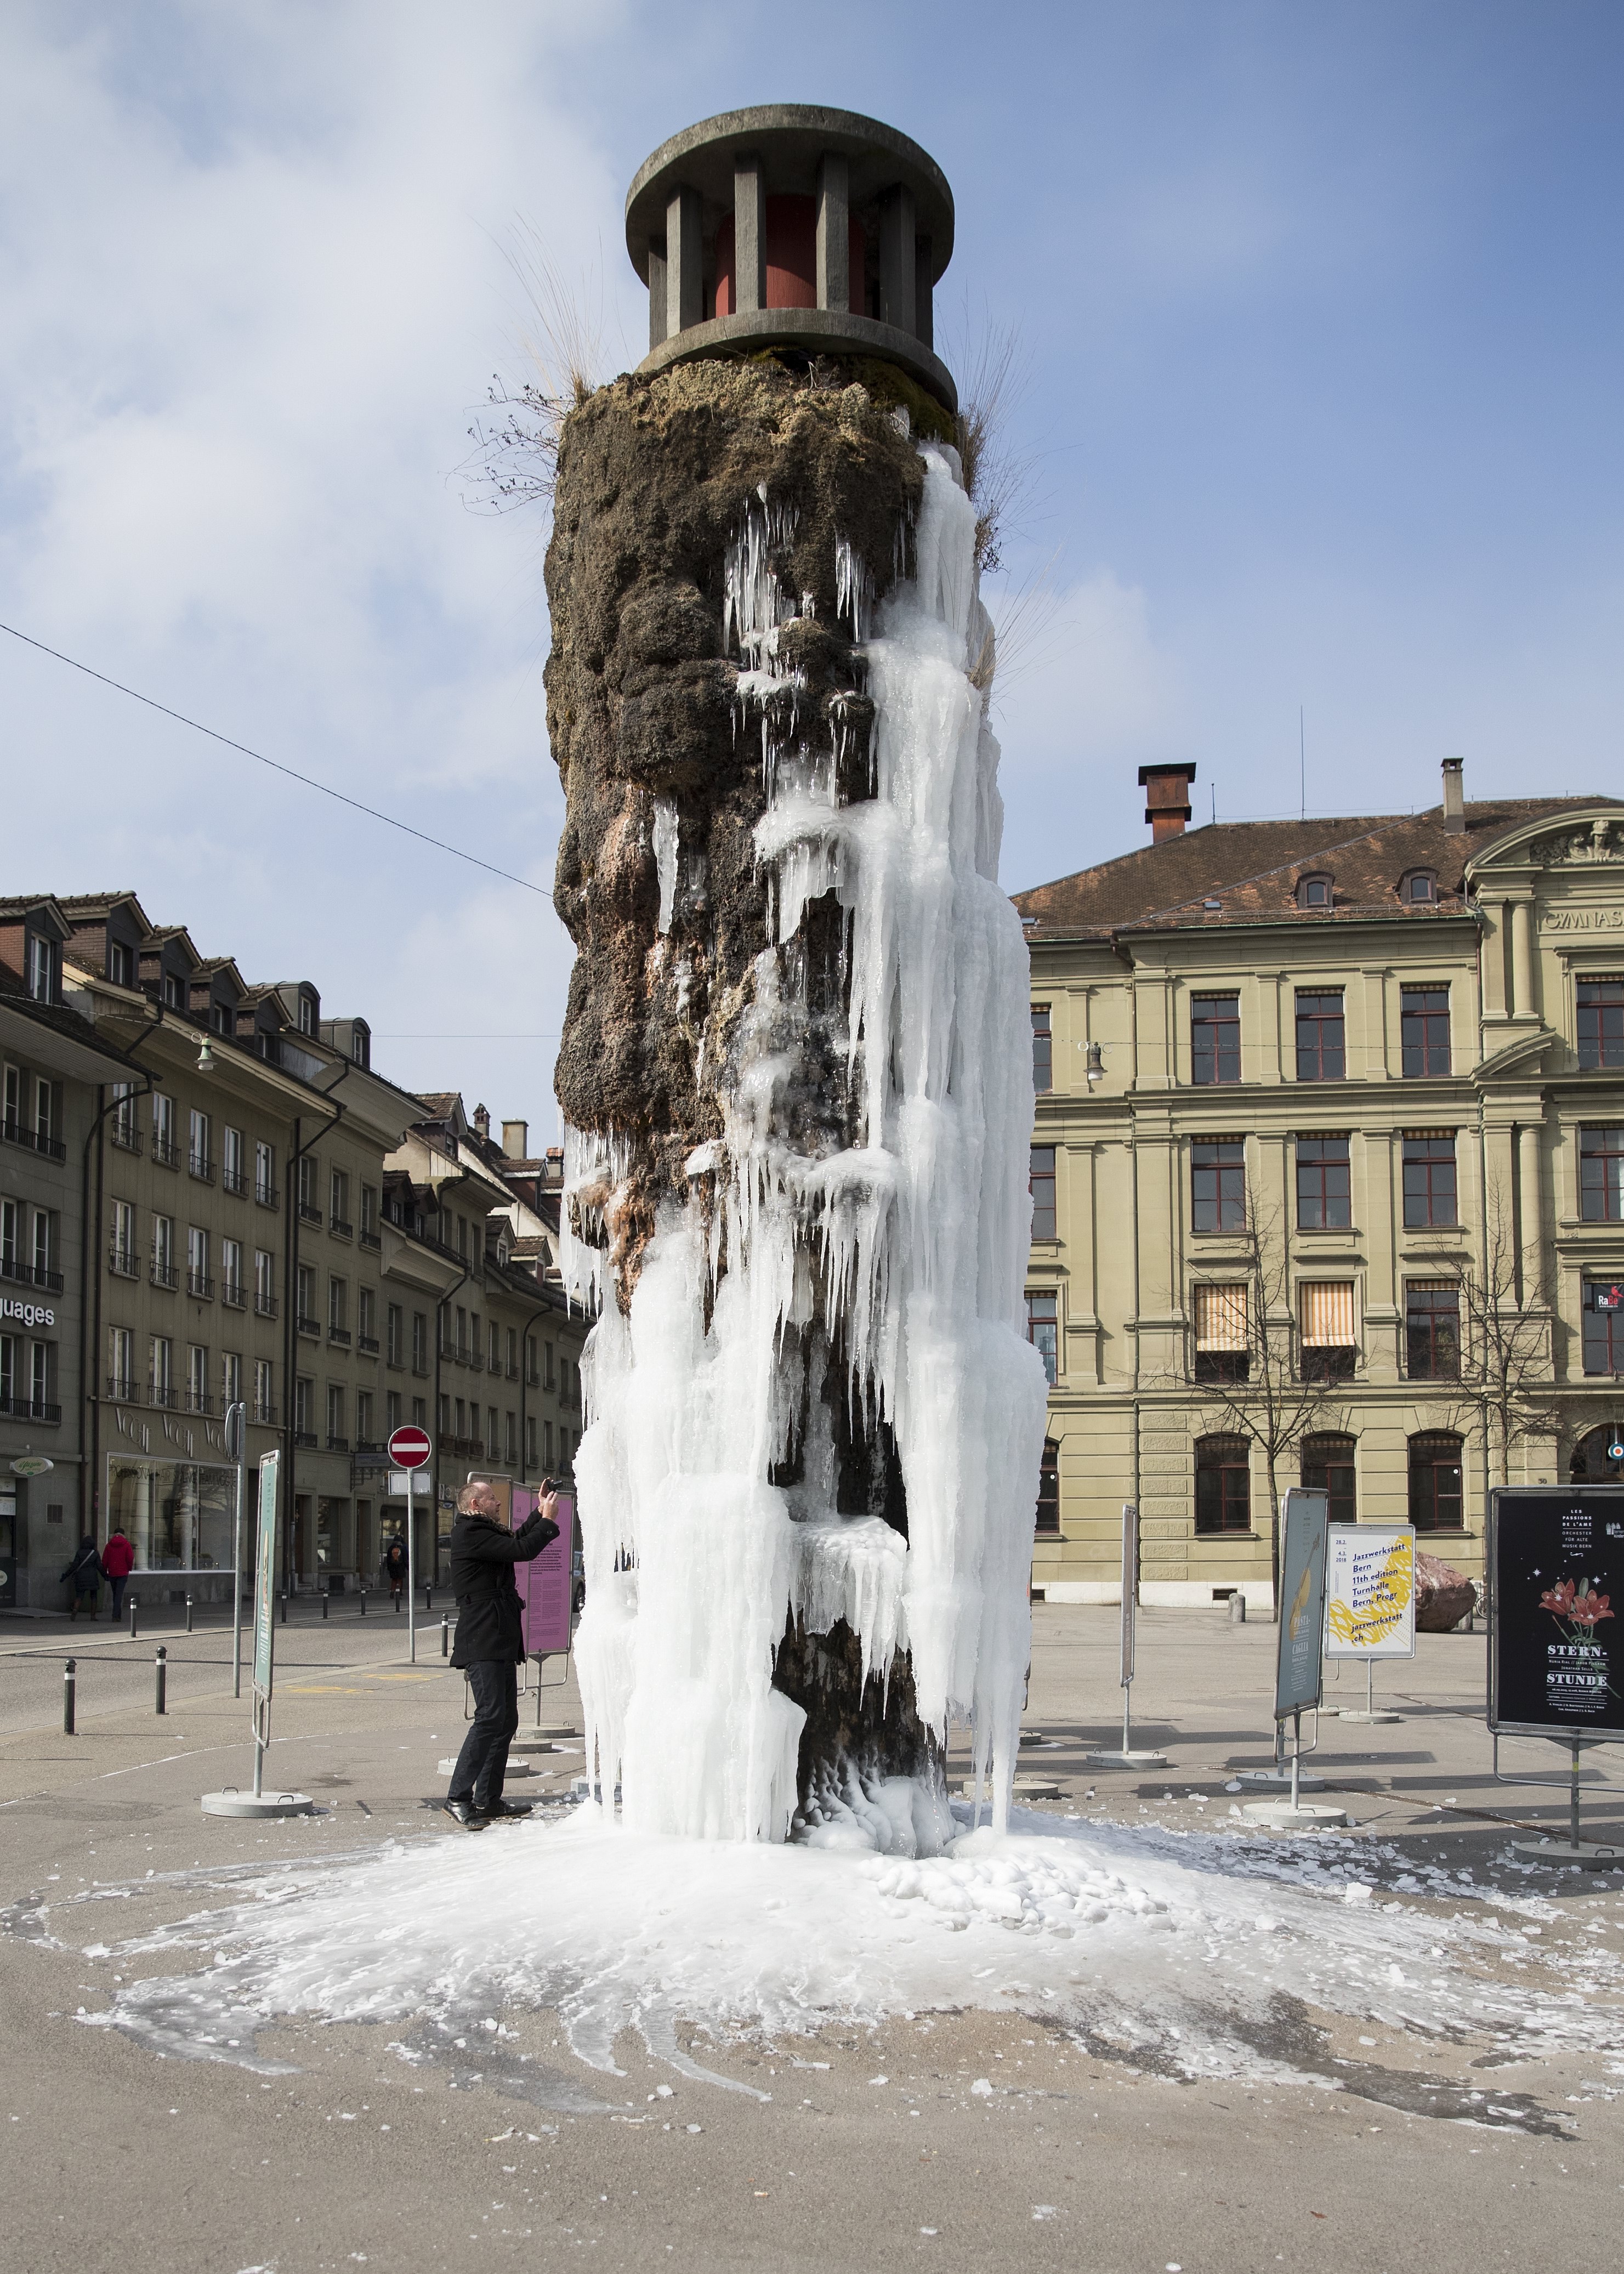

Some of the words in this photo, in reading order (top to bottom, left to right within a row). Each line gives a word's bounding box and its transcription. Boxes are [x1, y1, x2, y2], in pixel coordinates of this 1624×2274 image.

[1545, 912, 1624, 929] GYMNAS
[1598, 1295, 1618, 1305] RaBe
[1353, 1544, 1405, 1561] Jazzwerkstatt
[1353, 1564, 1371, 1572] Bern
[1353, 1575, 1369, 1584] 11th
[1371, 1569, 1398, 1579] edition
[1352, 1581, 1389, 1595] Turnhalle
[1353, 1598, 1374, 1607] Bern,
[1376, 1592, 1398, 1601] Progr
[1351, 1613, 1402, 1634] jazzwerkstatt
[1352, 1634, 1364, 1642] .ch
[1547, 1645, 1607, 1657] STERN-
[1547, 1674, 1607, 1686] STUNDE
